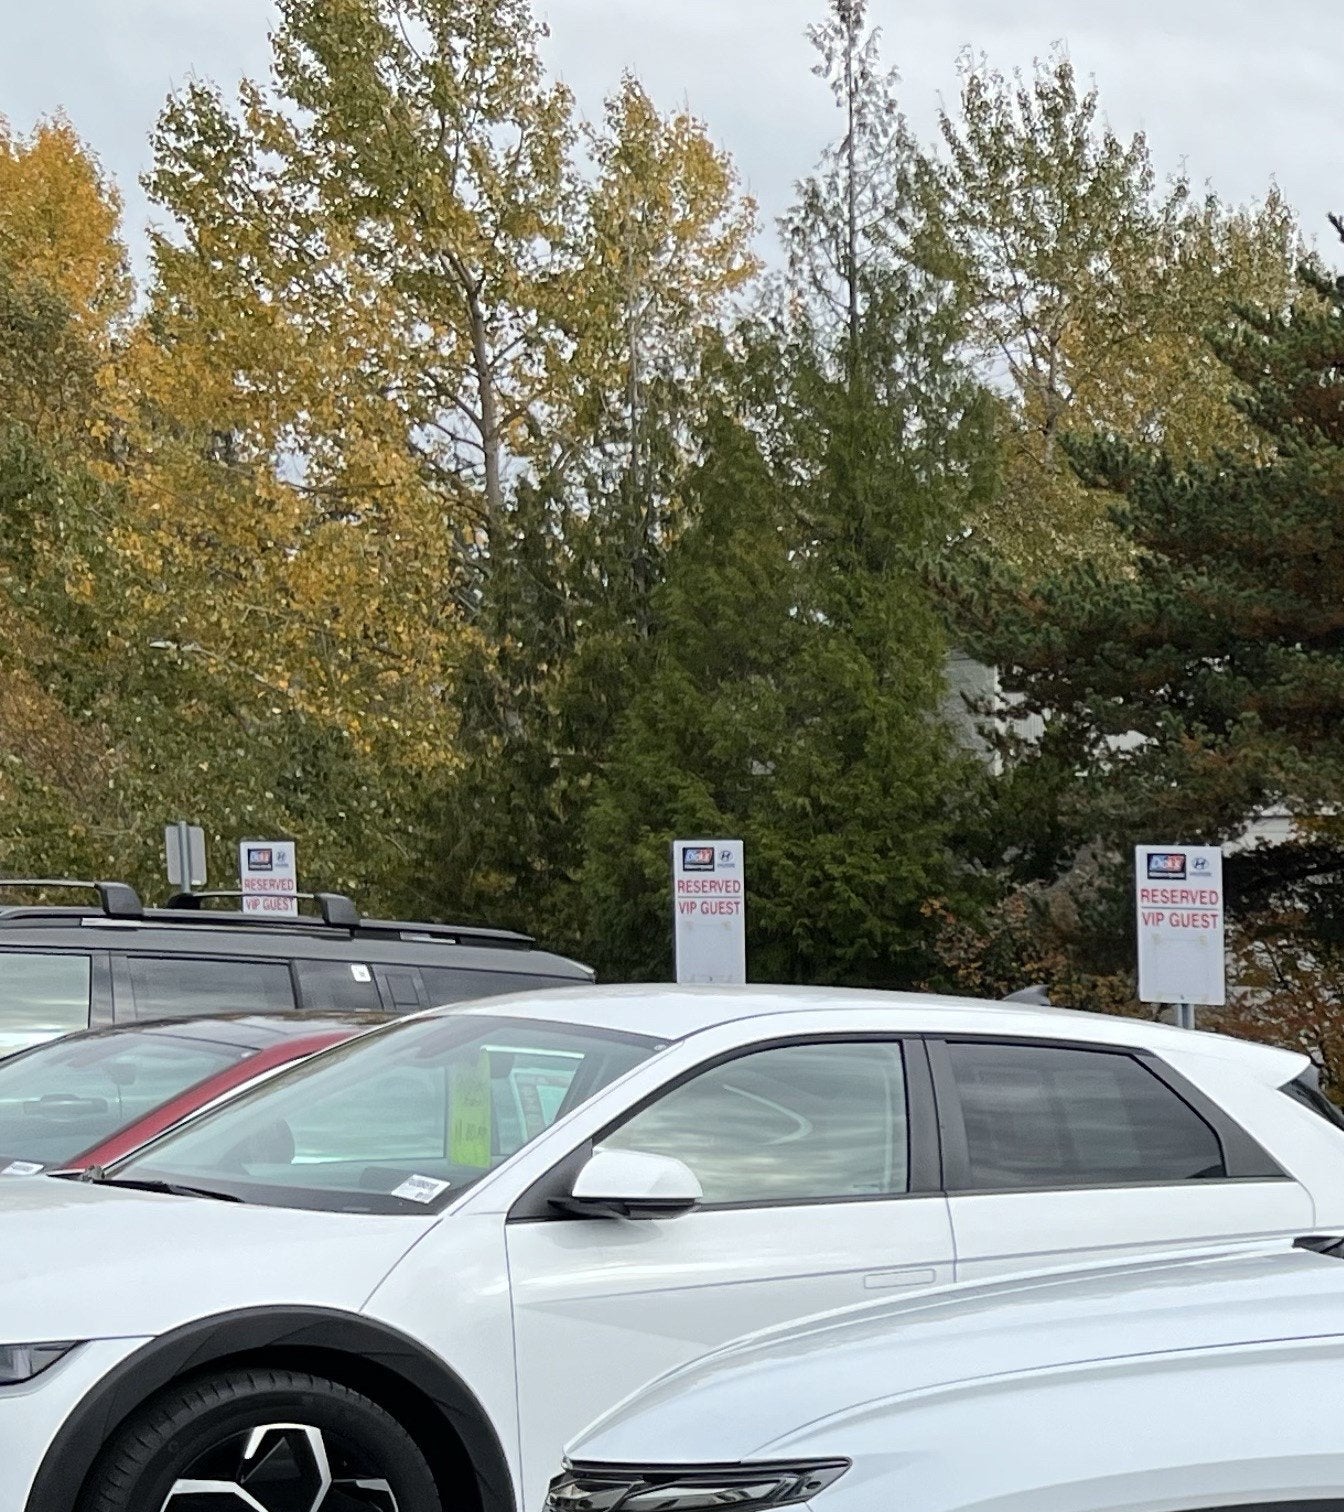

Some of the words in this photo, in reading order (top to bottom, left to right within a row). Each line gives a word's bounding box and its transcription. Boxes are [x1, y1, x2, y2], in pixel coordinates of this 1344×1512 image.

[677, 879, 741, 894] RESERVED
[1140, 888, 1219, 906] RESERVED
[678, 901, 697, 915] VIP
[700, 901, 741, 916] GUEST
[1141, 912, 1164, 927] VIP
[1169, 912, 1219, 929] GUEST
